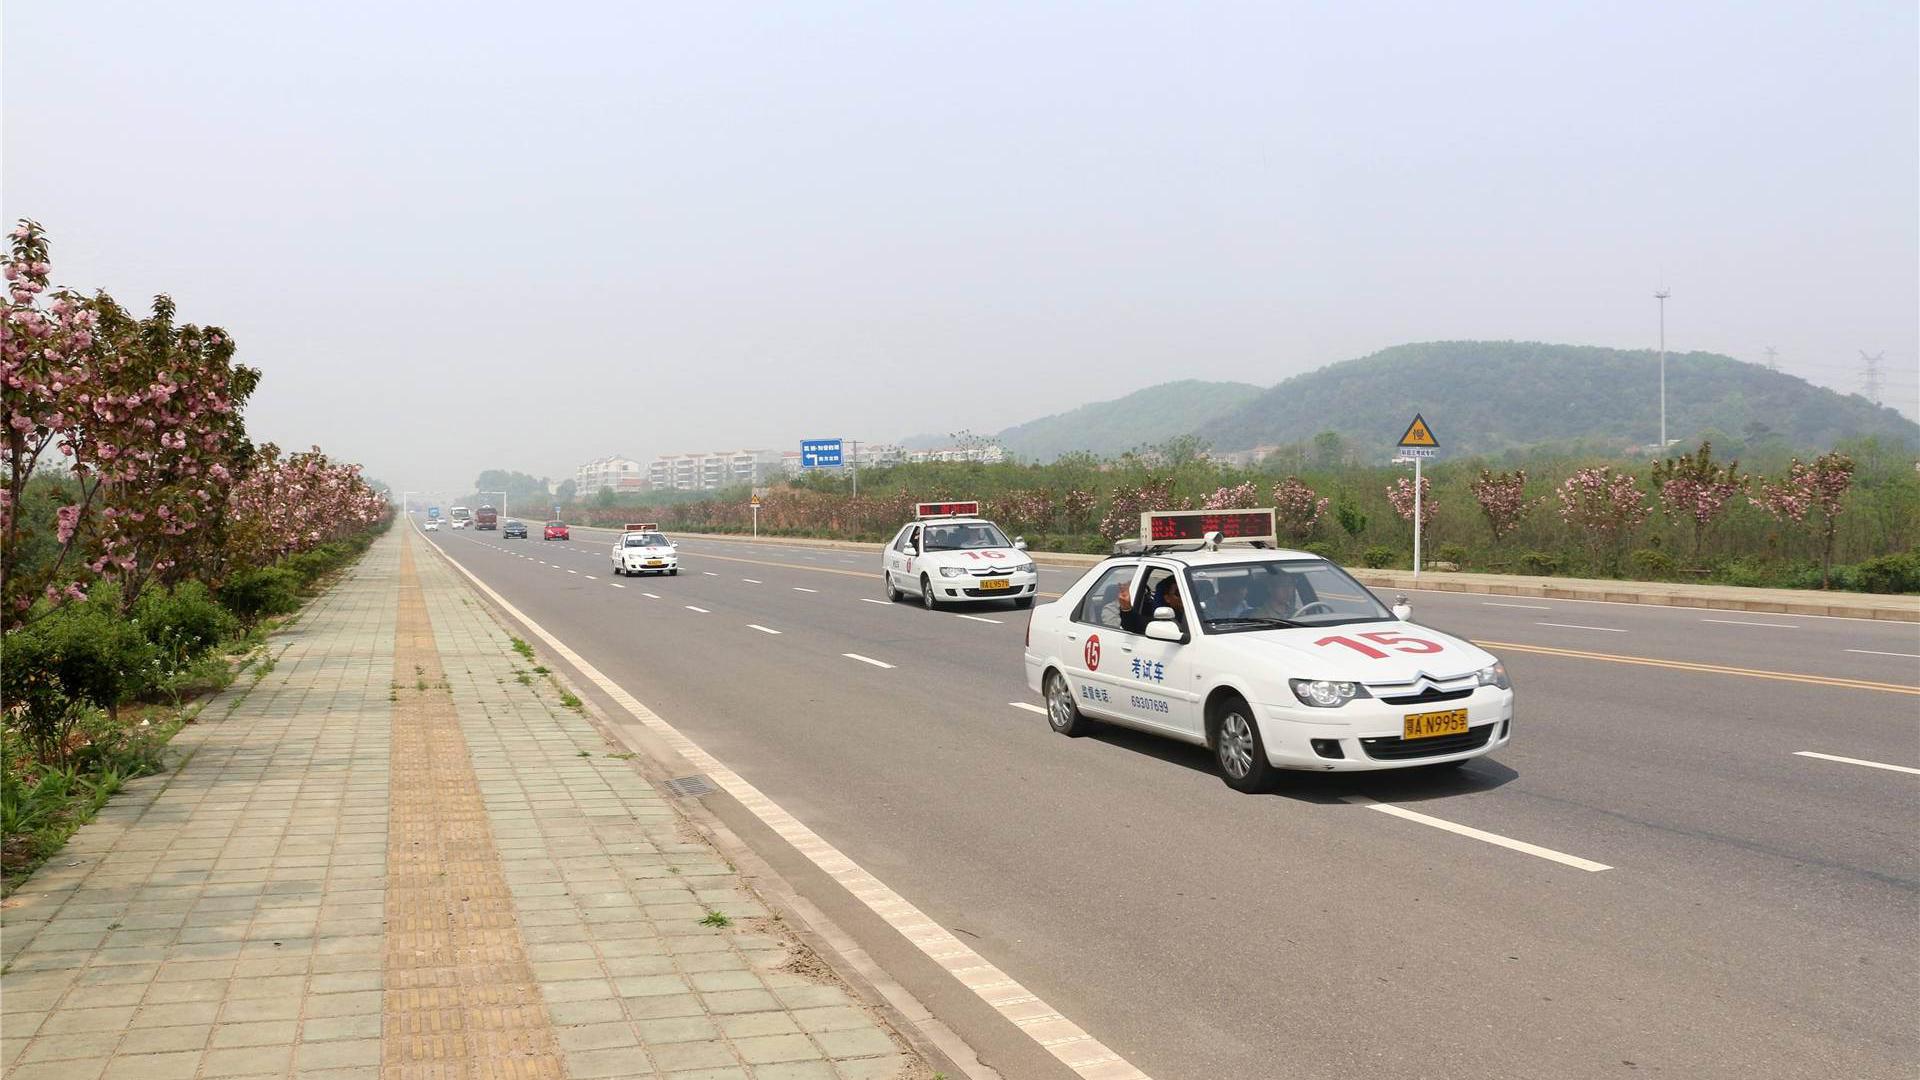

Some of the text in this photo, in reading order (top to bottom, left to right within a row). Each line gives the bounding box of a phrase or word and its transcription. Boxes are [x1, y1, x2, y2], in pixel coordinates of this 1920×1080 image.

[1413, 428, 1424, 440] 慢
[960, 550, 1006, 560] 16
[1086, 640, 1099, 667] 15
[1313, 631, 1444, 660] 15
[1131, 657, 1164, 683] 考试车
[1131, 695, 1169, 713] 69307699
